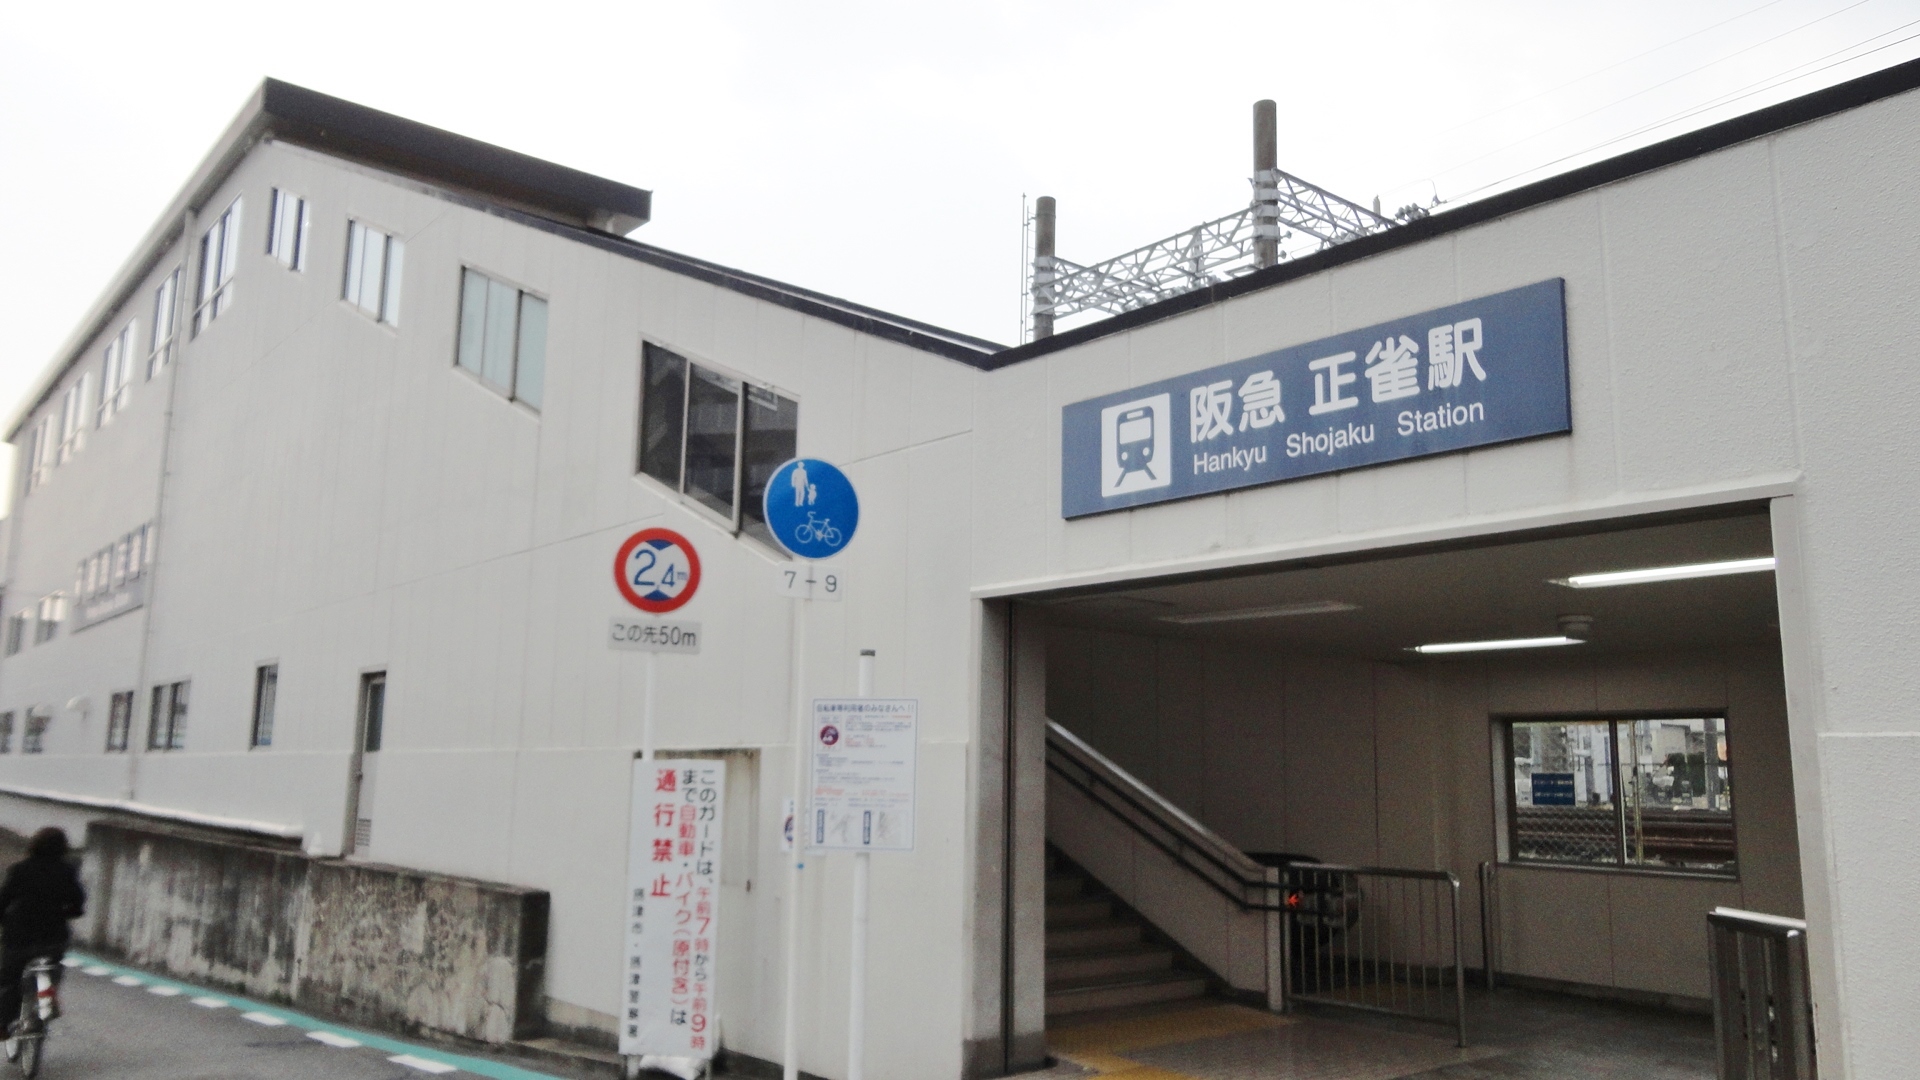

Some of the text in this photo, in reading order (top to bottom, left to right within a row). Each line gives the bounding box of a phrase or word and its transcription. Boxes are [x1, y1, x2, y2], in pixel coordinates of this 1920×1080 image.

[1190, 317, 1487, 443] 阪急 正雀駅
[1193, 401, 1484, 475] Hankyu Shojaku Station
[612, 623, 697, 646] この先50m
[651, 769, 676, 897] 通行禁止
